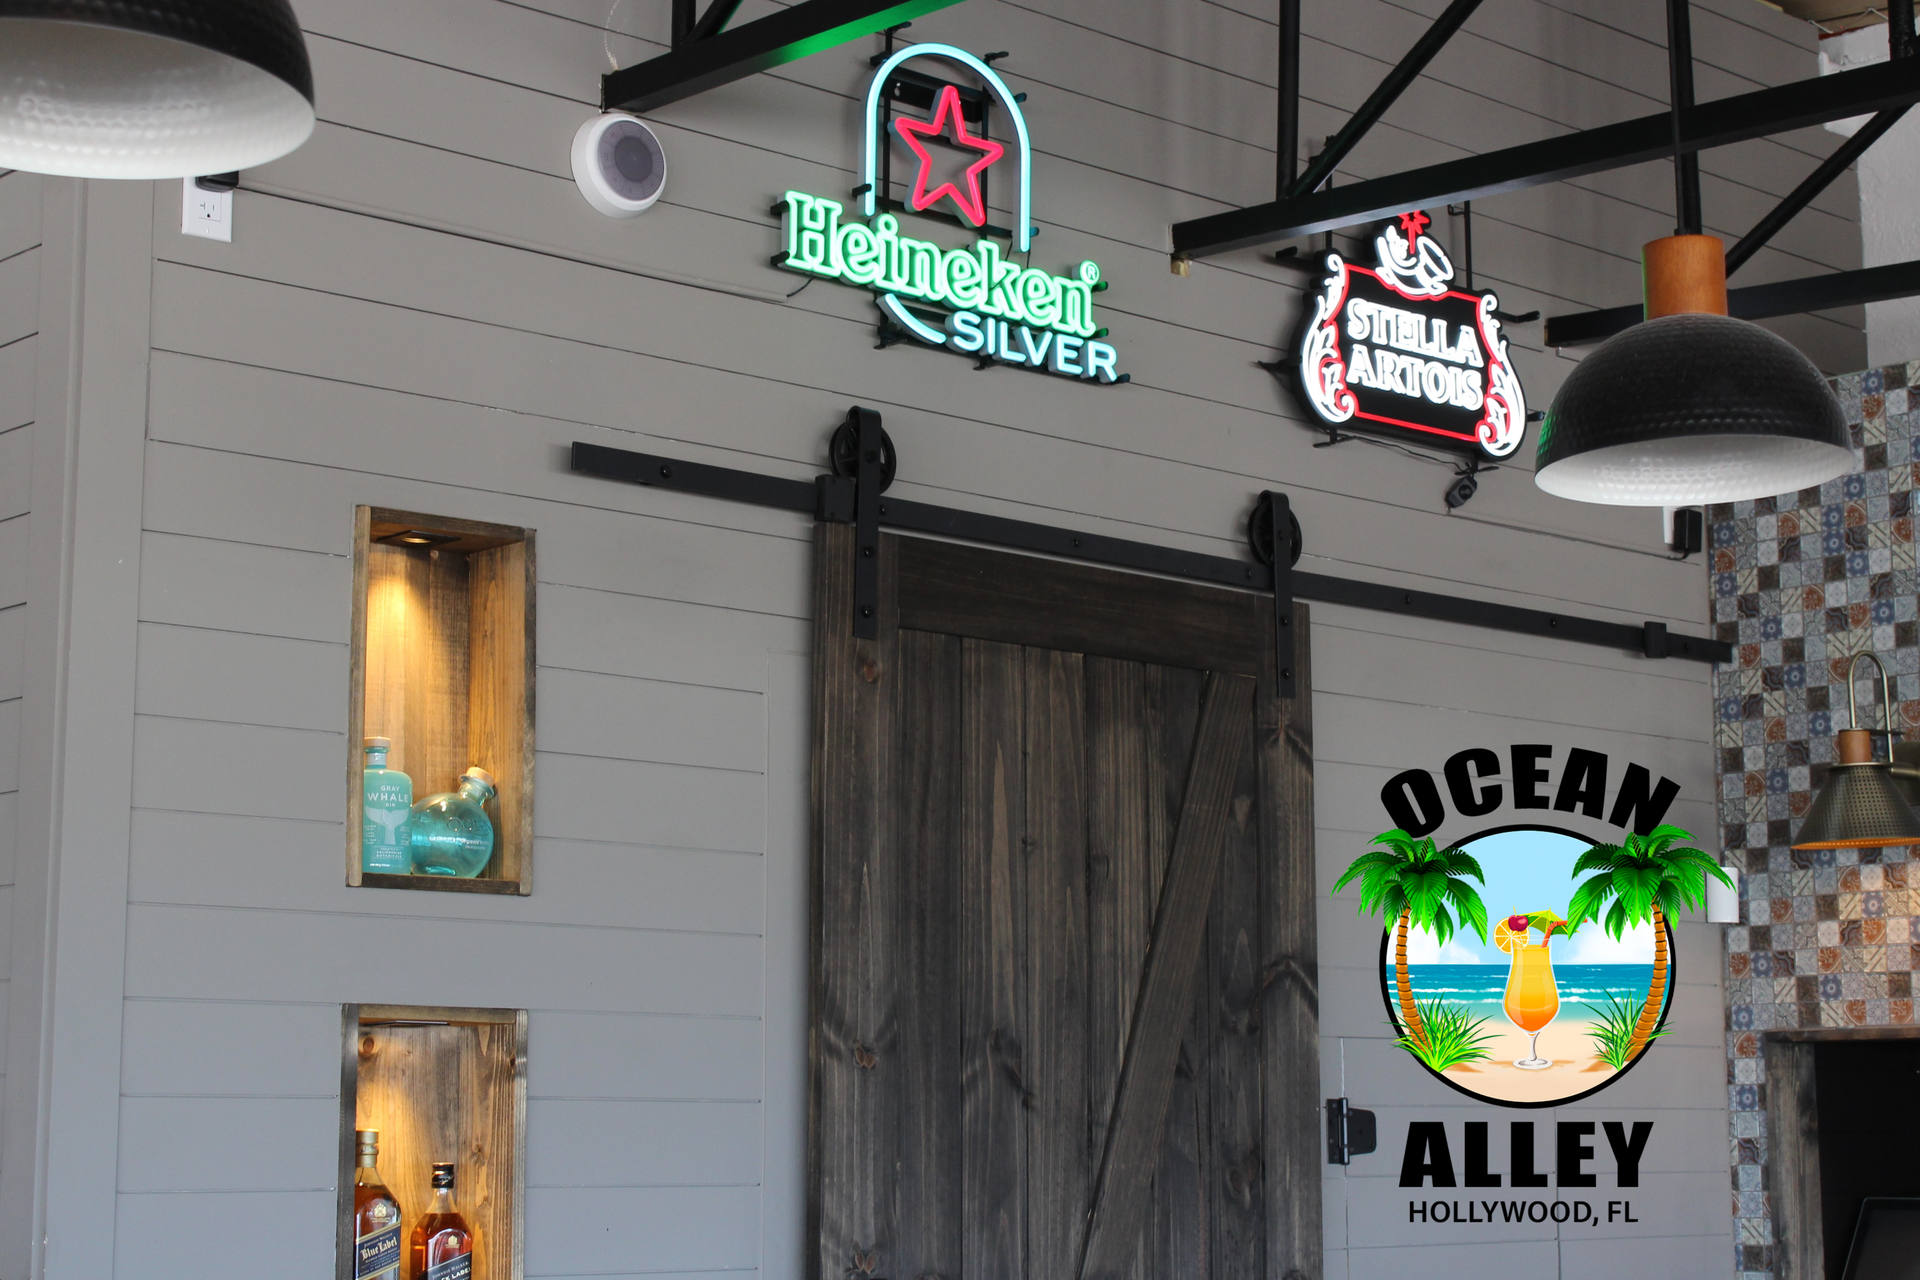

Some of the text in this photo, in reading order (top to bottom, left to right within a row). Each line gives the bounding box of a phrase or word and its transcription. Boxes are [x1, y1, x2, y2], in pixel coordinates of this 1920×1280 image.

[952, 310, 1118, 383] SILVER
[1346, 297, 1484, 368] STELLA
[1345, 343, 1485, 411] ARTOIS
[367, 792, 409, 803] WHALE
[360, 1246, 379, 1261] Blue
[377, 1236, 398, 1253] Label
